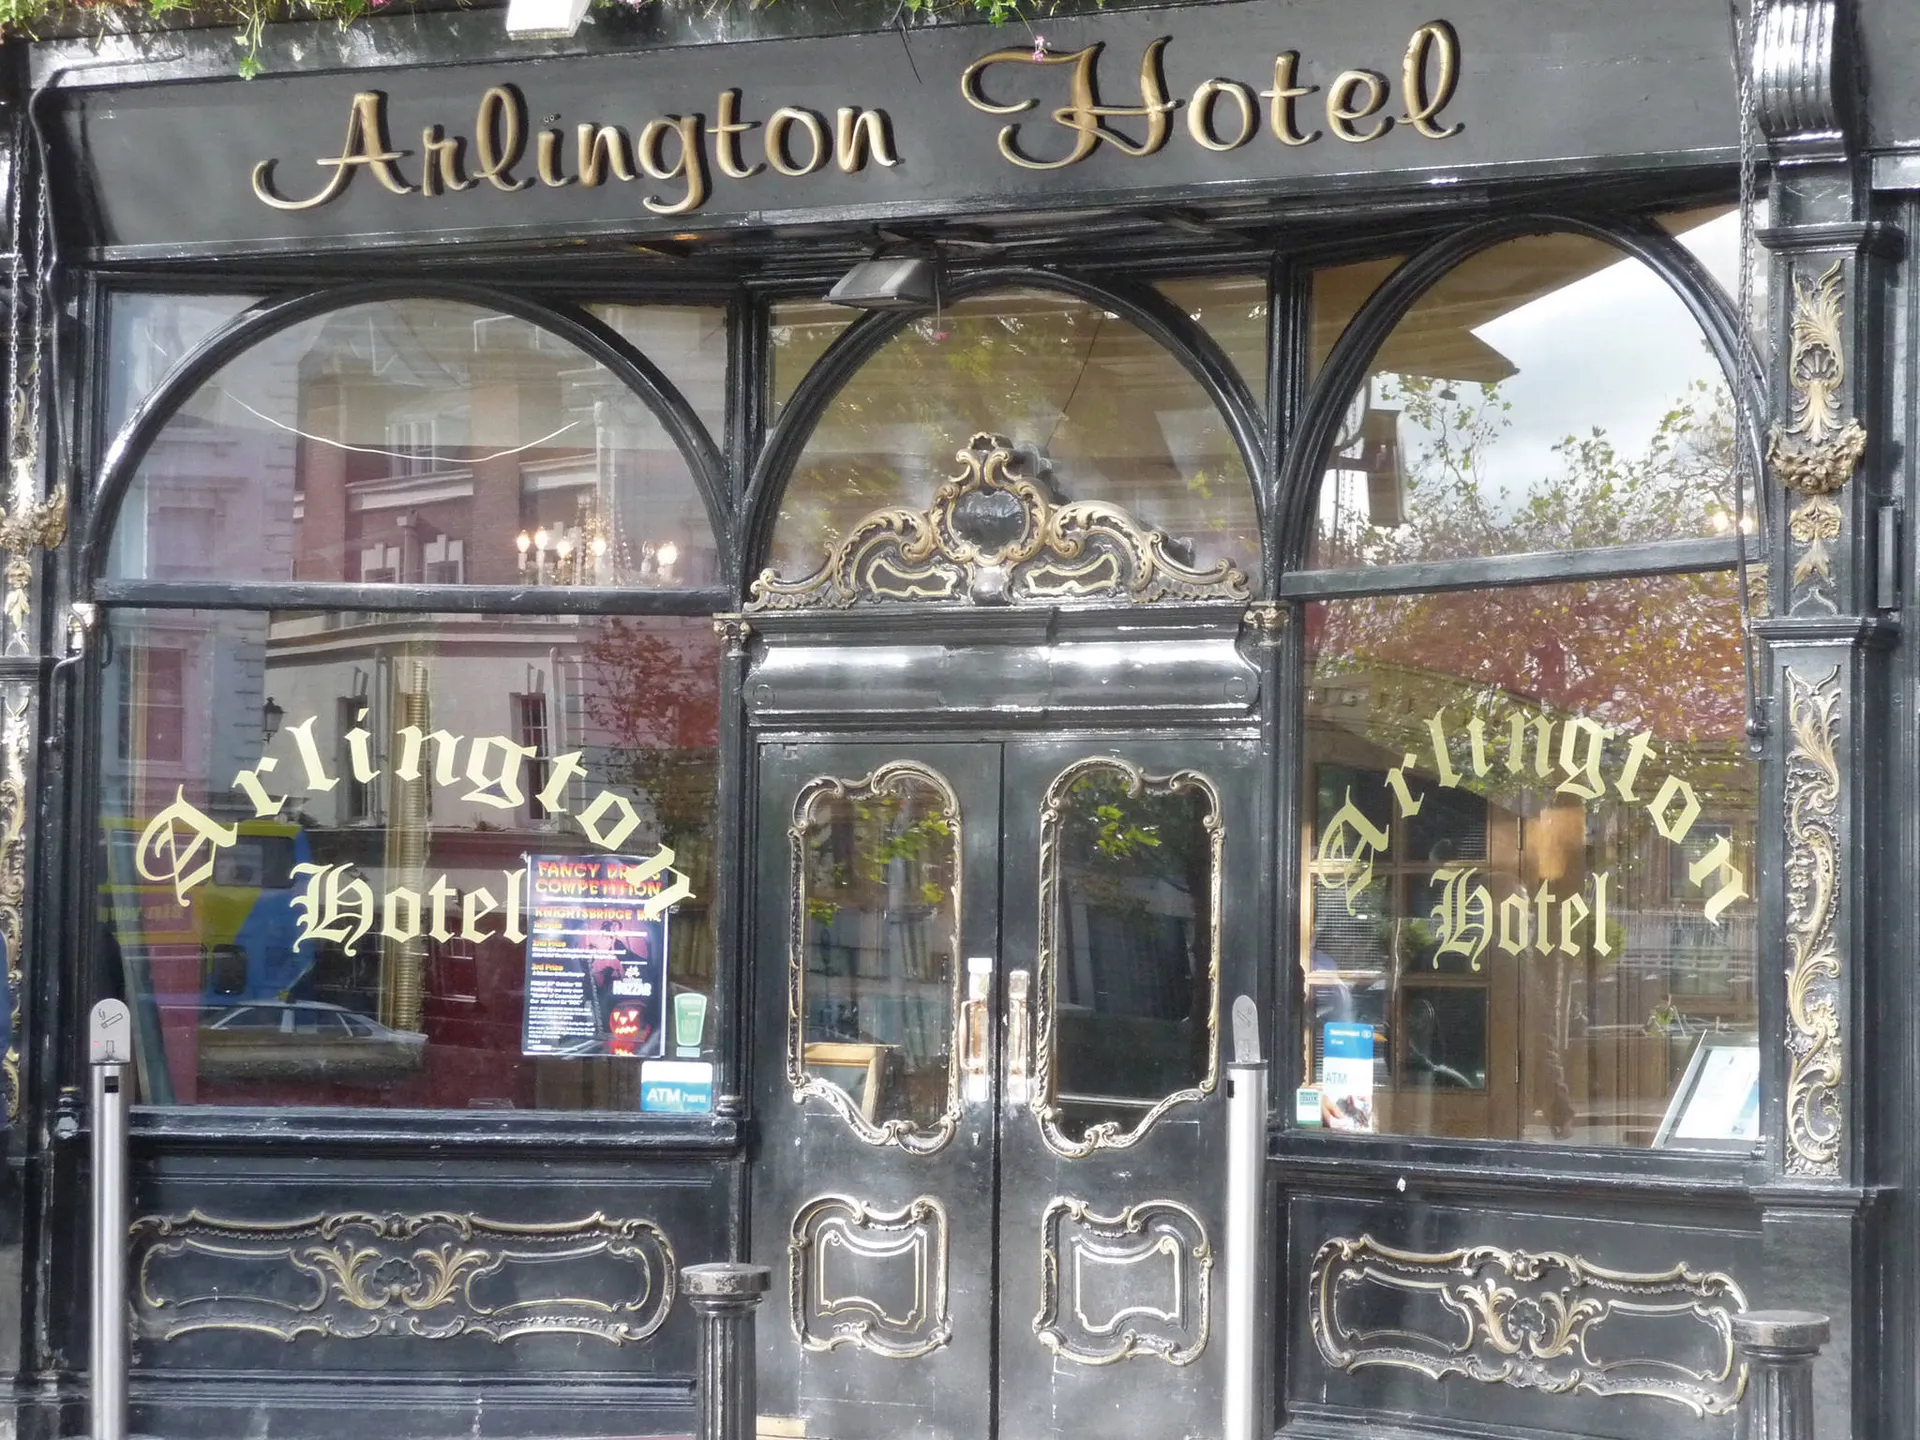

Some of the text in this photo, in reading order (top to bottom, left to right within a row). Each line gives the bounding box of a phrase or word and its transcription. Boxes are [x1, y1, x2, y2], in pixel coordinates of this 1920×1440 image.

[252, 18, 1465, 215] Arlington Hotel
[135, 707, 698, 917] Arlington
[1317, 705, 1750, 927] Arlington
[289, 862, 528, 957] Hotel
[534, 880, 663, 898] COMPETITION
[534, 906, 633, 920] KNIGHTSBRIDGE
[537, 862, 600, 879] FANCY
[1429, 866, 1612, 973] Hotel
[646, 1087, 682, 1102] ATM
